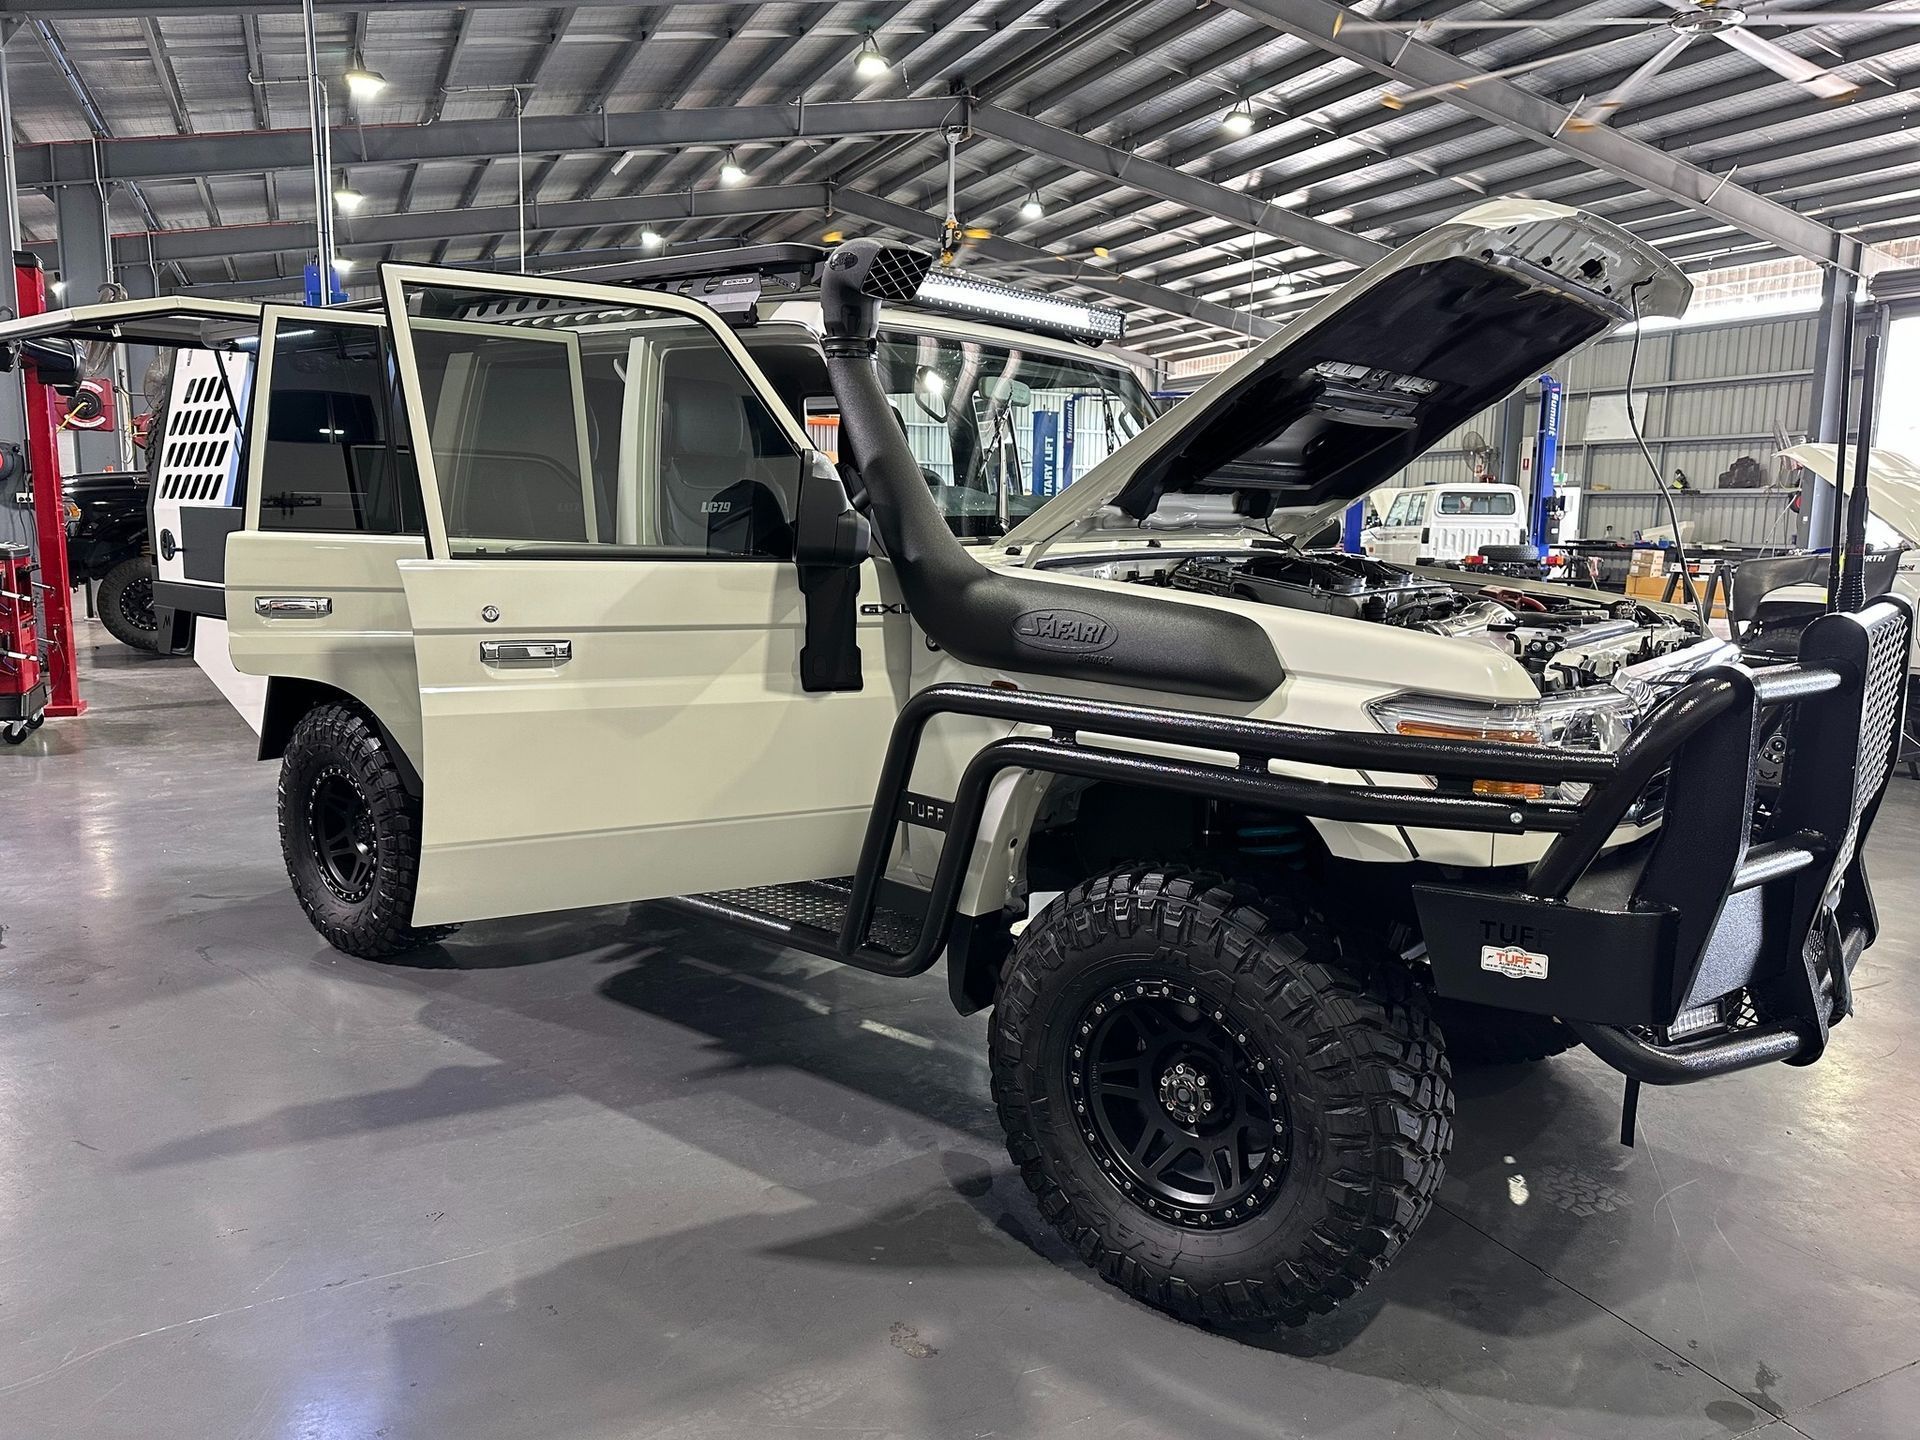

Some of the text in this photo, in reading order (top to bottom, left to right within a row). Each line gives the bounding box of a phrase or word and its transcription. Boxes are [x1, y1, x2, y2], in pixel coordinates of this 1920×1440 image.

[1066, 402, 1074, 440] Summit
[1549, 392, 1559, 437] Summit
[1044, 436, 1054, 497] TARY LIFT
[701, 501, 731, 513] LC79
[1864, 555, 1887, 563] RTH
[861, 604, 910, 615] GXL
[1019, 613, 1107, 644] SAFARI
[907, 801, 944, 821] TUFF
[1496, 952, 1533, 966] TUFF
